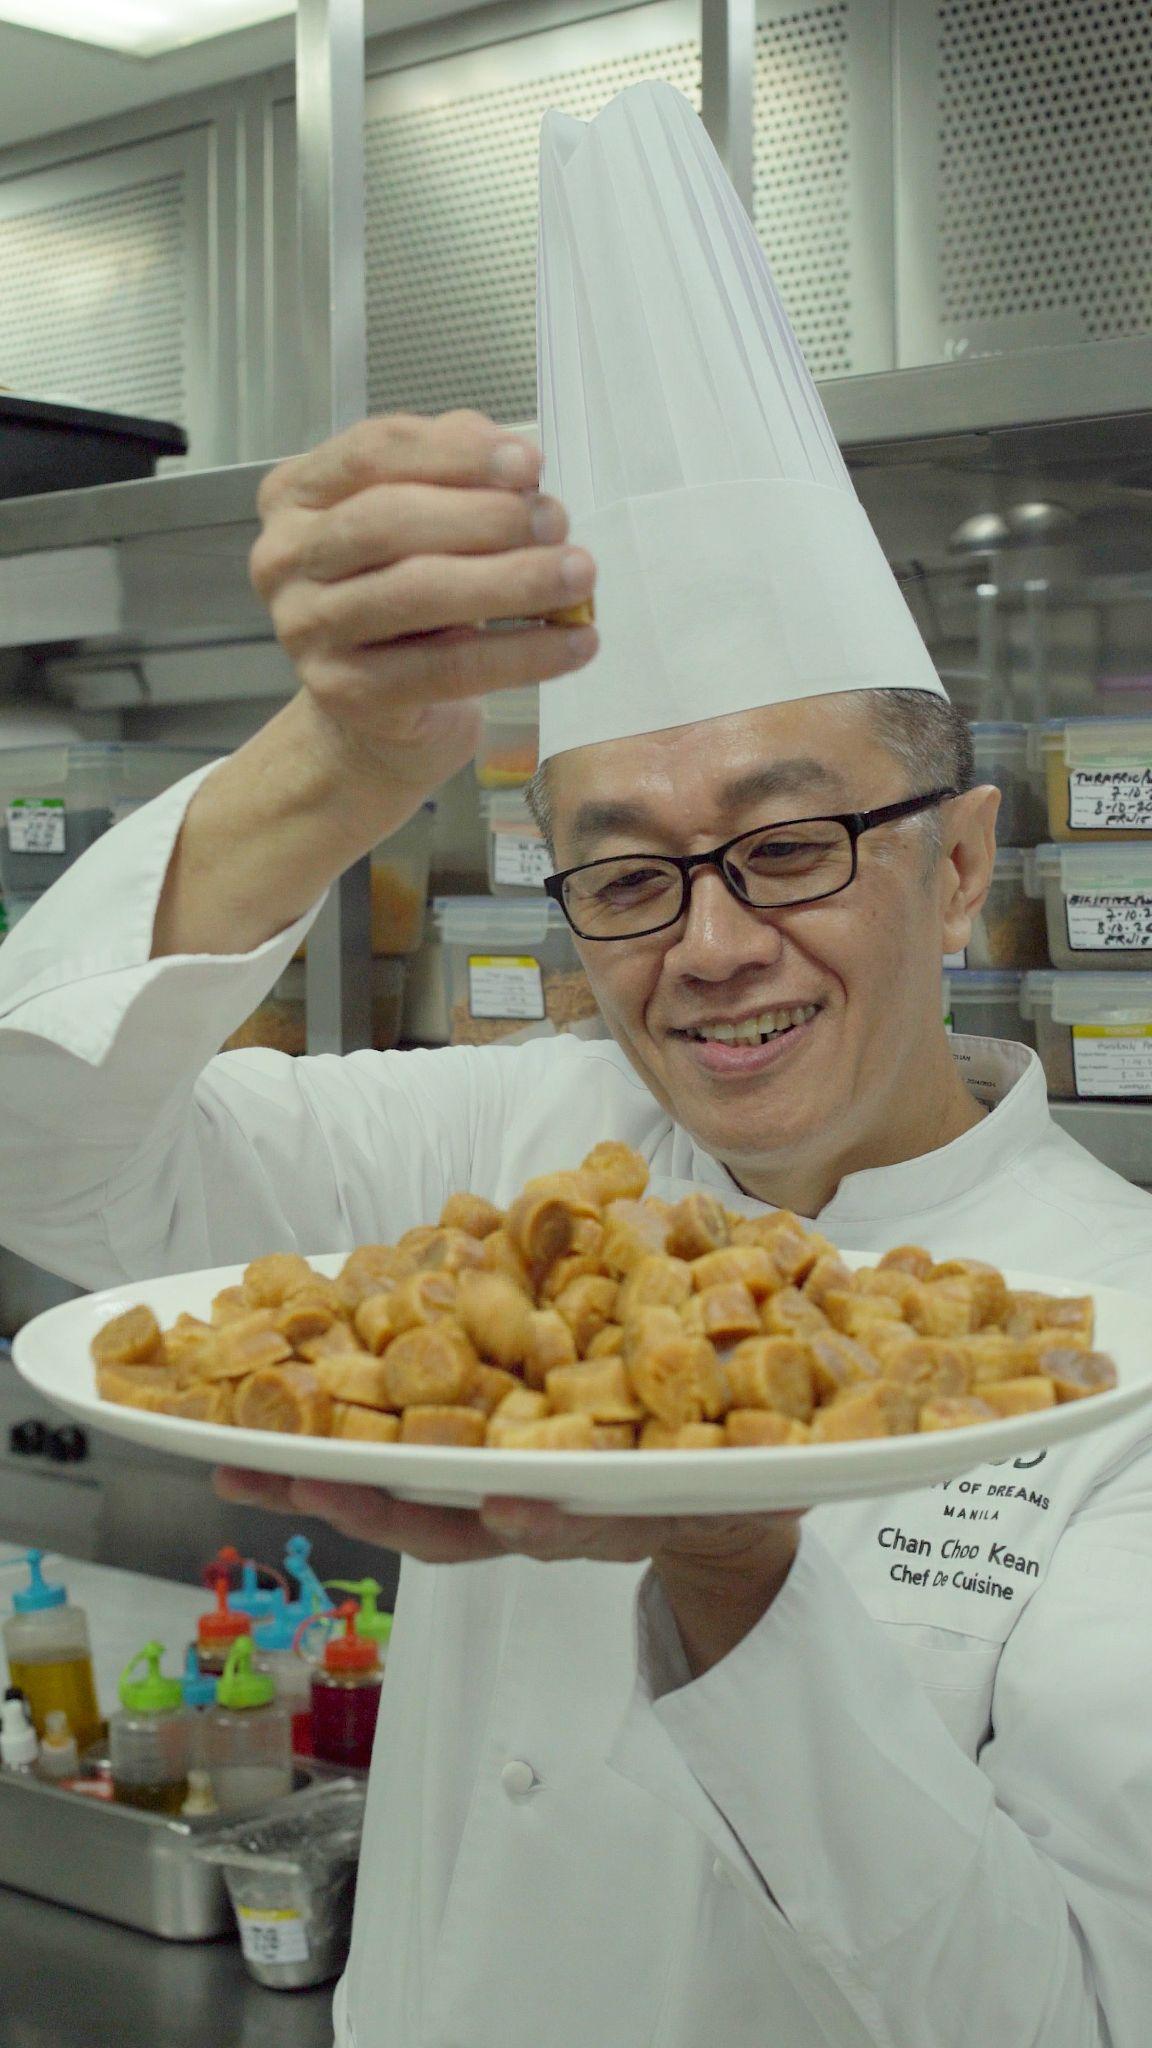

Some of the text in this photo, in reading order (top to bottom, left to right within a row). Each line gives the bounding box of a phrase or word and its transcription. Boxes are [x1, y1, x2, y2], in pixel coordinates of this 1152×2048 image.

[959, 1481, 982, 1493] OF
[987, 1485, 1050, 1510] DREAMS
[943, 1505, 999, 1520] MANILA
[877, 1527, 1040, 1577] Chan Choo Kean
[890, 1564, 1014, 1600] Chef De Cuisine
